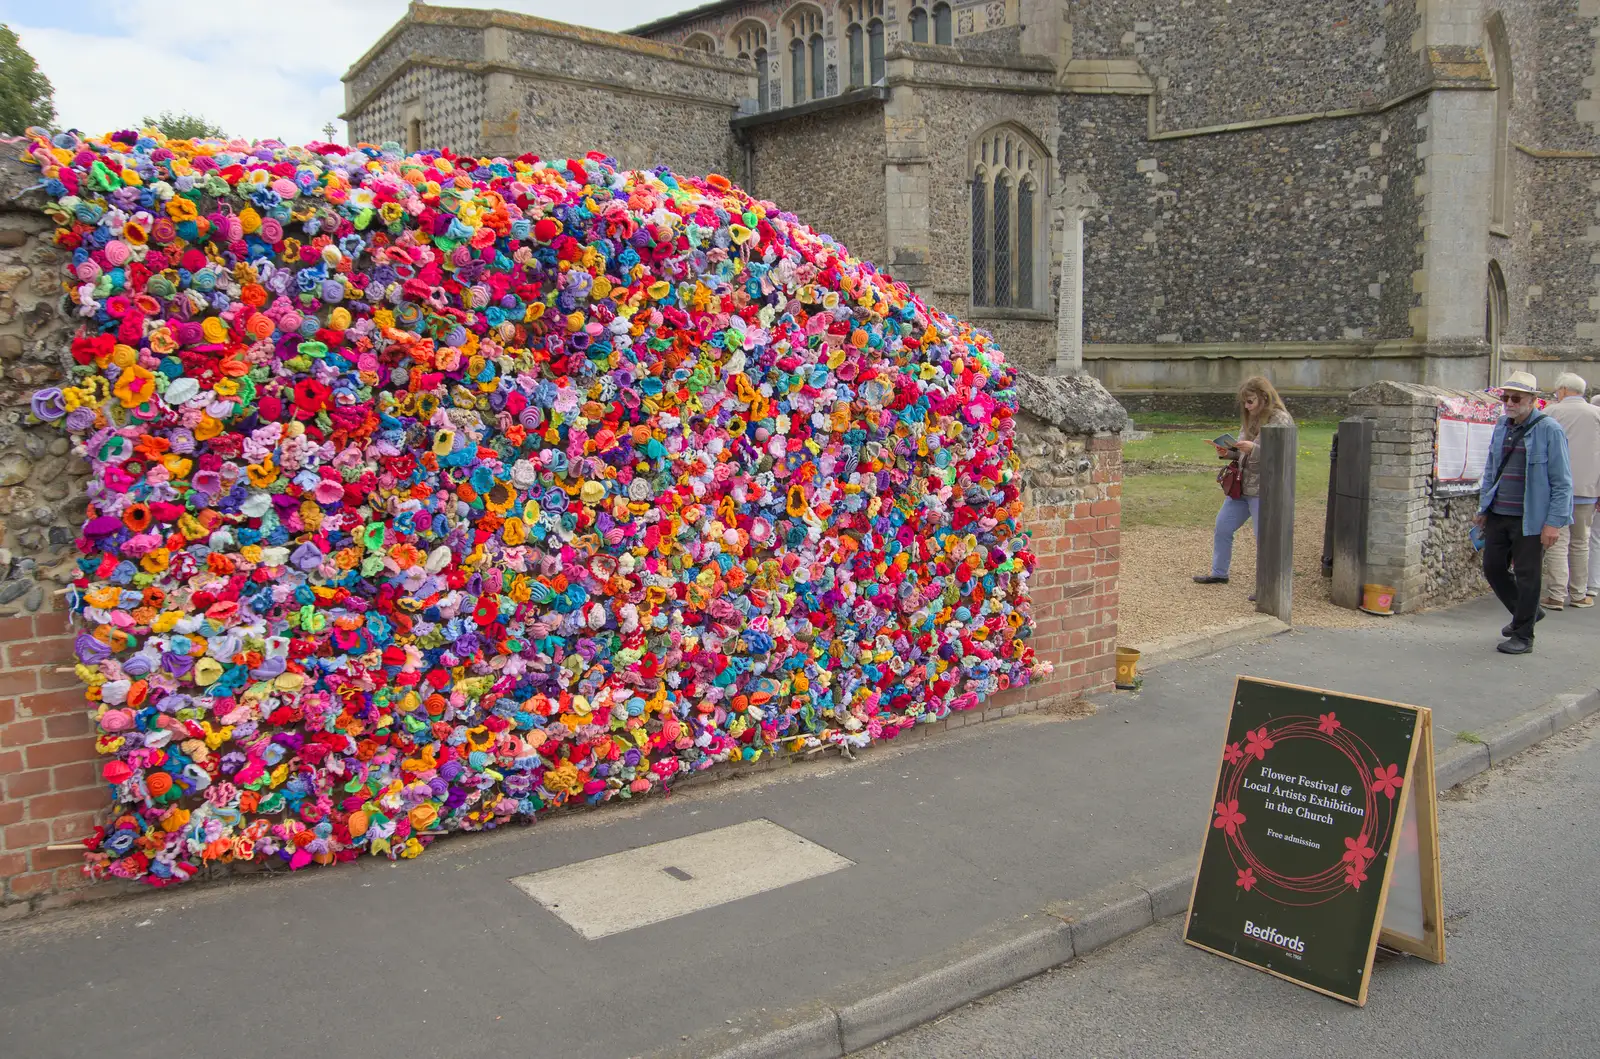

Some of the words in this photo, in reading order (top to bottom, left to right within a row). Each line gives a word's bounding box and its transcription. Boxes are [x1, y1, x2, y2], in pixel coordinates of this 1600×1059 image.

[1260, 767, 1296, 784] Flower
[1298, 775, 1338, 794] Festival
[1340, 785, 1352, 796] &
[1243, 778, 1271, 793] Local
[1272, 786, 1307, 802] Artists
[1309, 794, 1364, 817] Exhibition
[1265, 799, 1275, 810] in
[1277, 803, 1293, 815] the
[1295, 807, 1334, 825] Church
[1267, 828, 1283, 839] Free
[1284, 835, 1320, 849] admission
[1243, 920, 1305, 952] Bedfords
